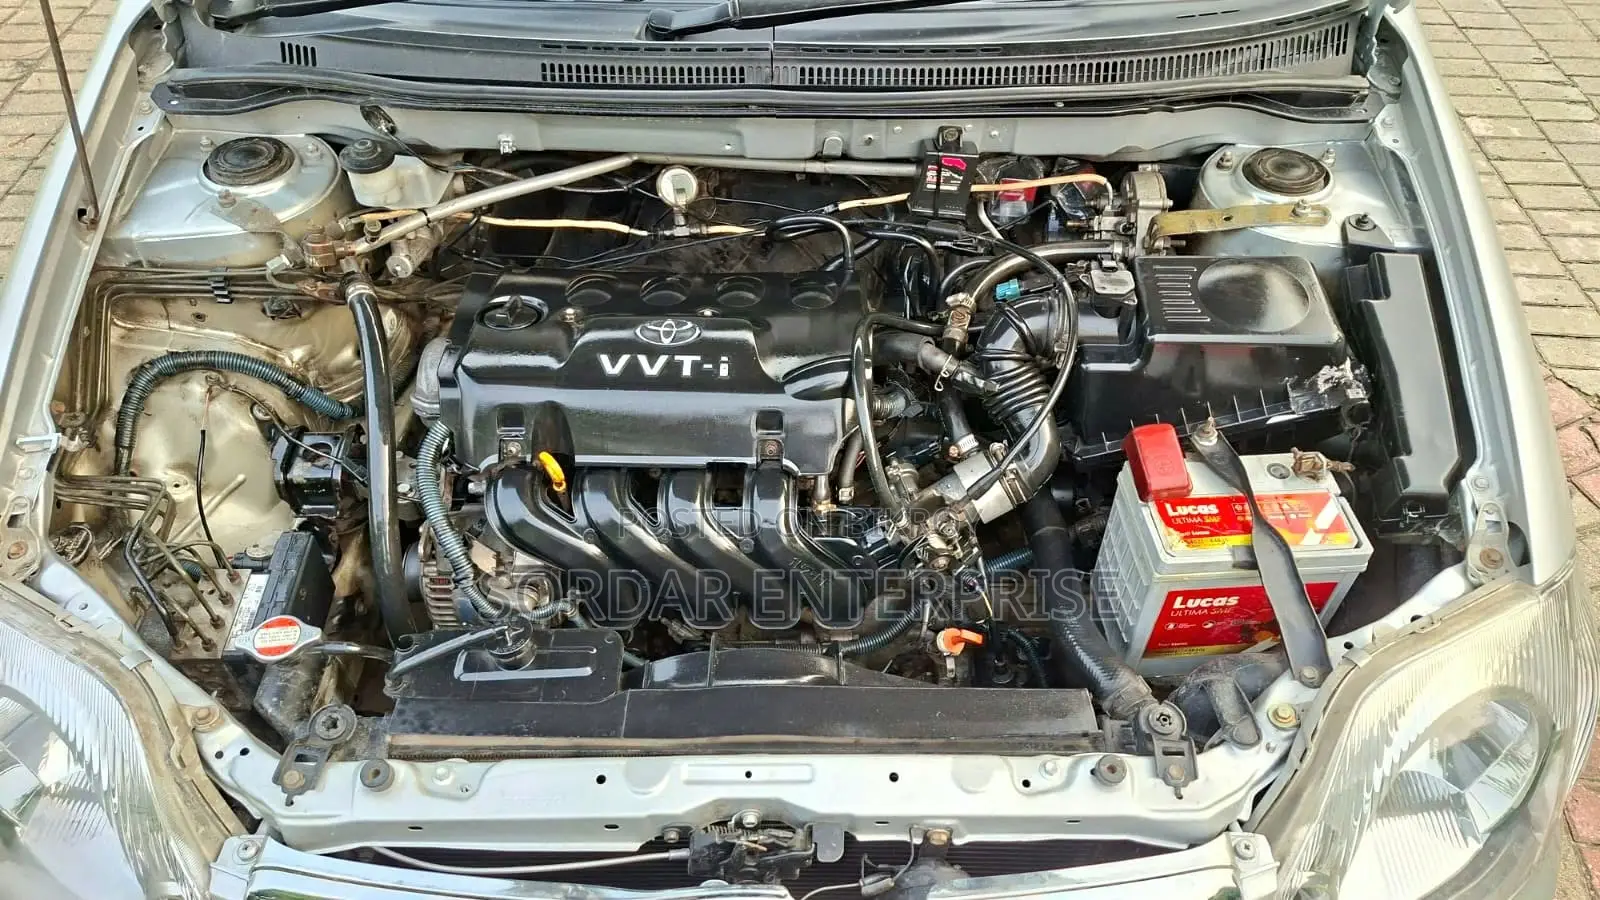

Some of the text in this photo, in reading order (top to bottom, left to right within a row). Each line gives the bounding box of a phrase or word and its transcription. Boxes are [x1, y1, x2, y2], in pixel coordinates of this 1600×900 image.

[599, 354, 729, 377] VVT-i
[1164, 502, 1219, 517] Lucas
[1171, 516, 1203, 525] ULTIMA
[1173, 596, 1241, 609] Lucas
[1171, 609, 1209, 617] ULTIMA
